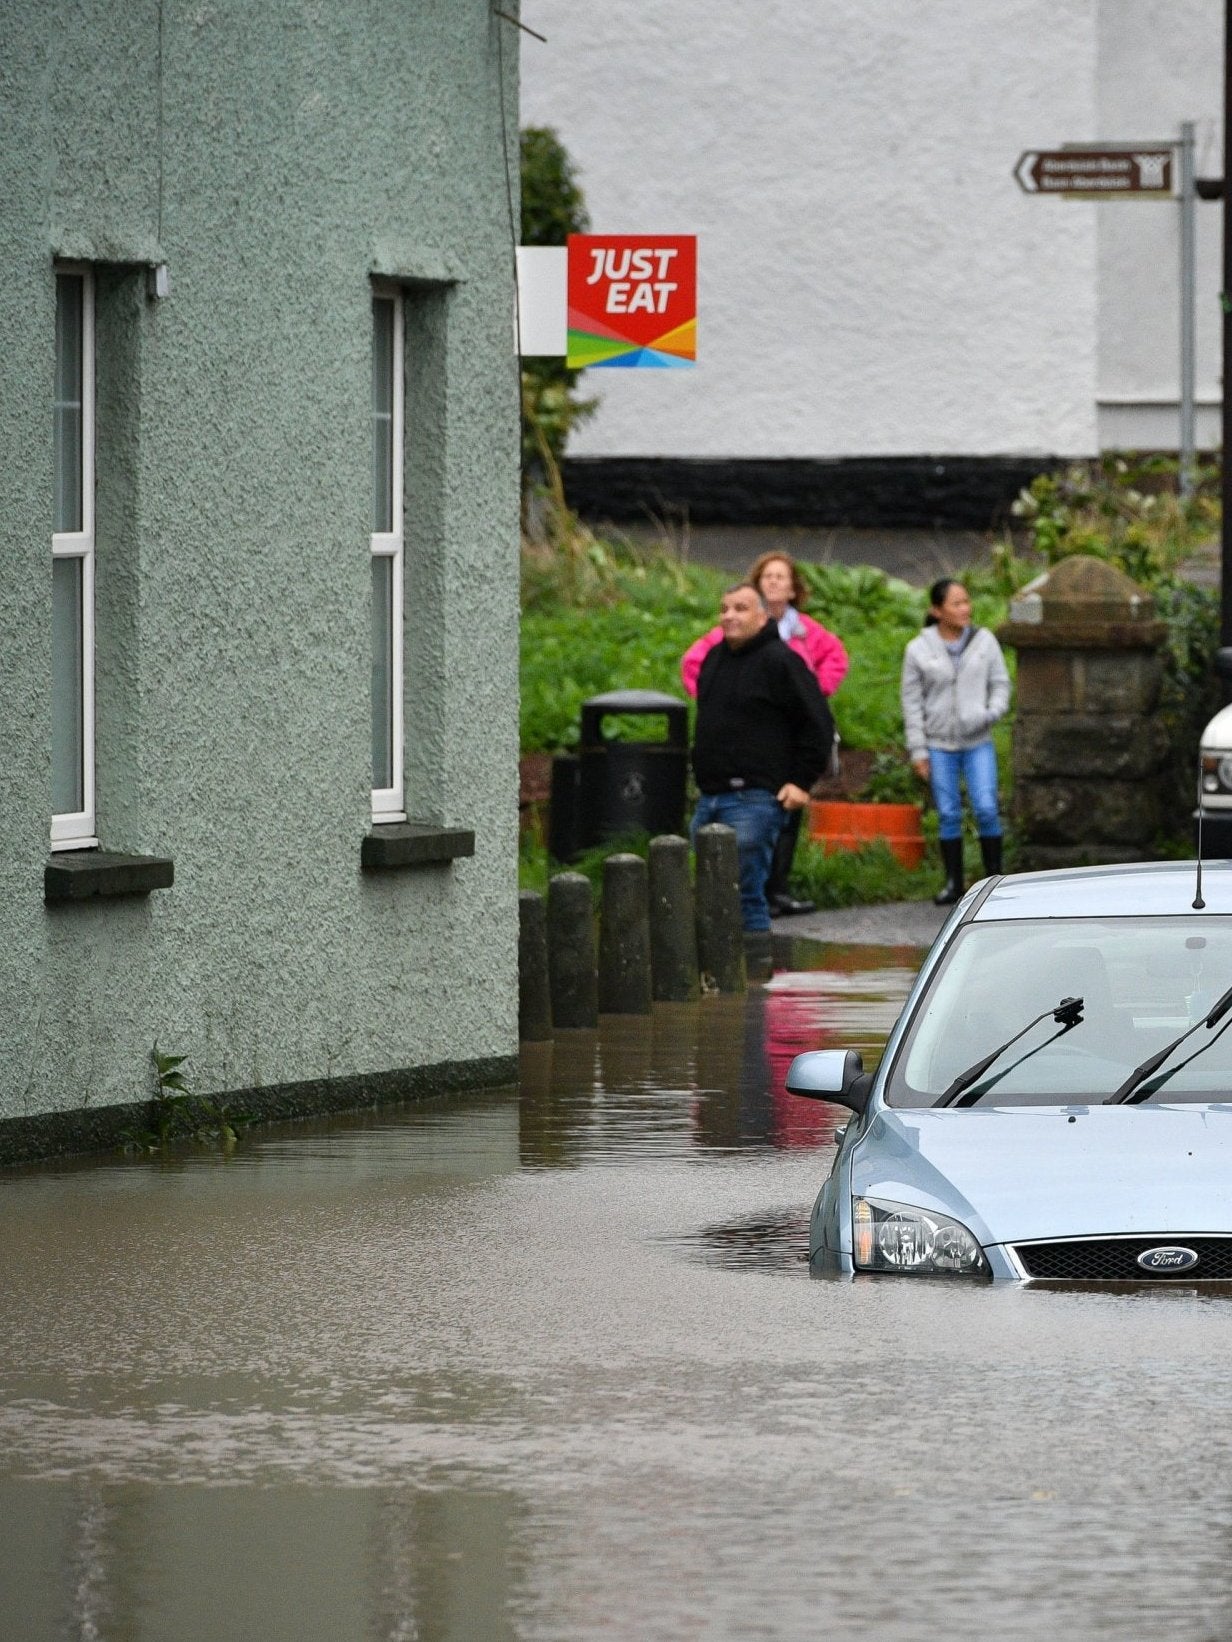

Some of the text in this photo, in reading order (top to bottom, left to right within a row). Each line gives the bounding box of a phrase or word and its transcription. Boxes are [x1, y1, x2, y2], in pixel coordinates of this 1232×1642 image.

[586, 248, 678, 285] JUST
[606, 282, 678, 314] EAT
[1151, 1251, 1184, 1266] Ford
